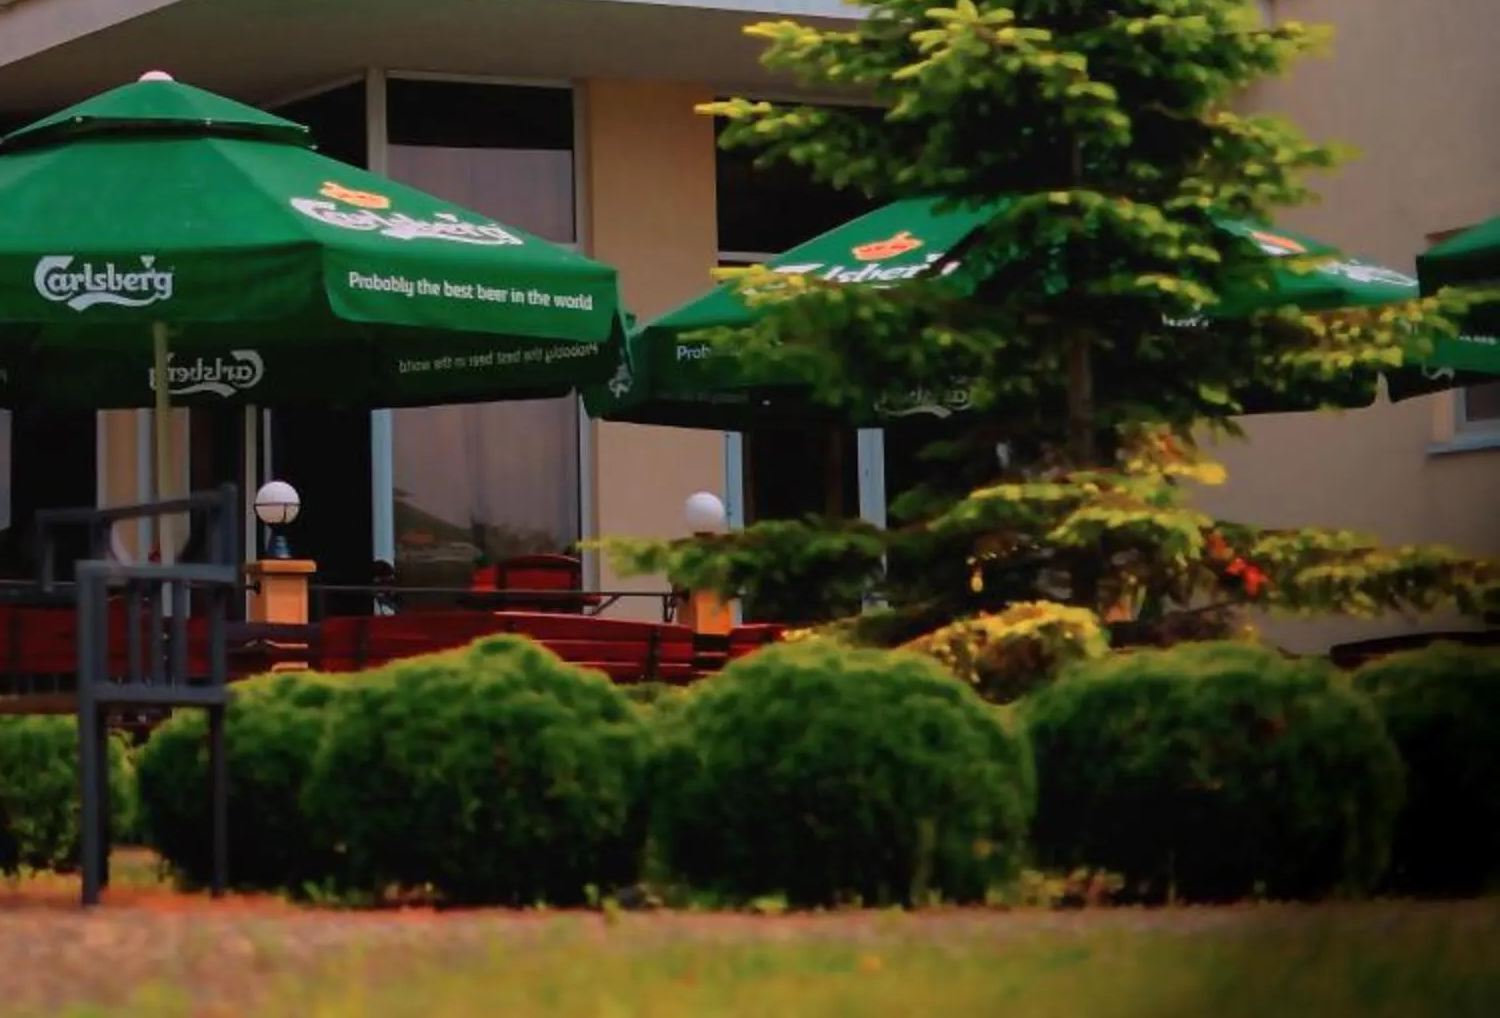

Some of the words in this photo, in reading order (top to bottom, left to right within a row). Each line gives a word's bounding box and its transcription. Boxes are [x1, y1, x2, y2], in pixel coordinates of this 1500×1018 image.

[34, 255, 173, 313] Carlsberg
[349, 271, 414, 297] Probably
[417, 277, 440, 296] the
[443, 281, 474, 299] best
[477, 284, 509, 302] beer
[511, 288, 525, 304] in
[527, 289, 551, 306] the
[554, 294, 593, 311] world
